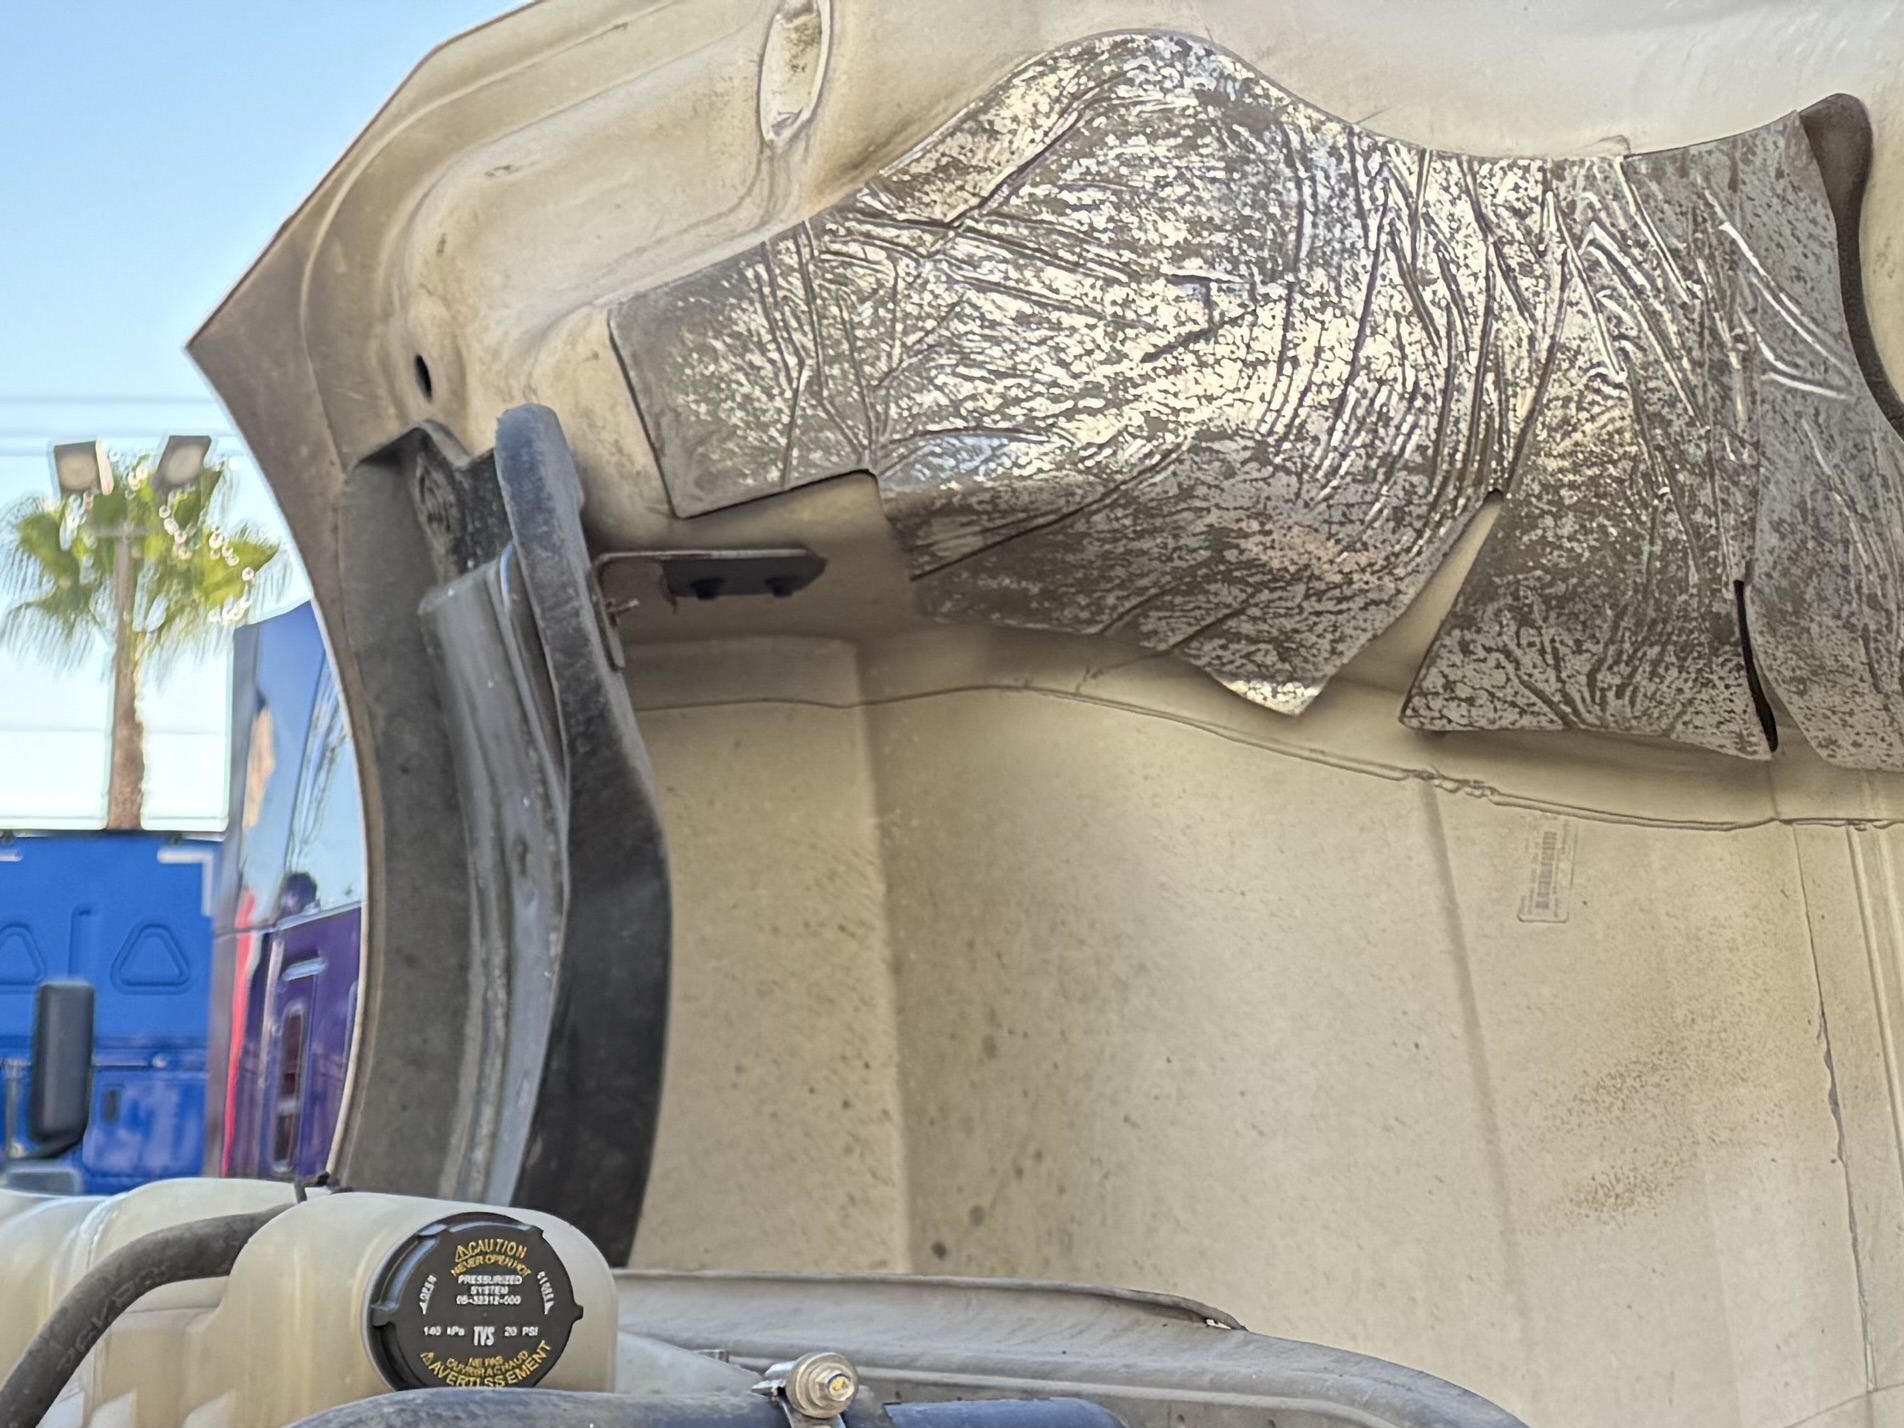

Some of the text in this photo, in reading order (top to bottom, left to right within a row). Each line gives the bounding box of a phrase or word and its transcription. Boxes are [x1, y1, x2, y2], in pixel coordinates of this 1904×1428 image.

[468, 1238, 528, 1259] CAUTION
[450, 1254, 533, 1278] NEVER OPEN HOT
[457, 1274, 523, 1285] PRESSURIZED
[470, 1285, 509, 1295] SYSTEM
[423, 1326, 465, 1337] 140 kPa
[473, 1325, 495, 1346] TVS
[504, 1326, 539, 1337] 20 PSI
[429, 1339, 552, 1388] AVERTISSEMENT
